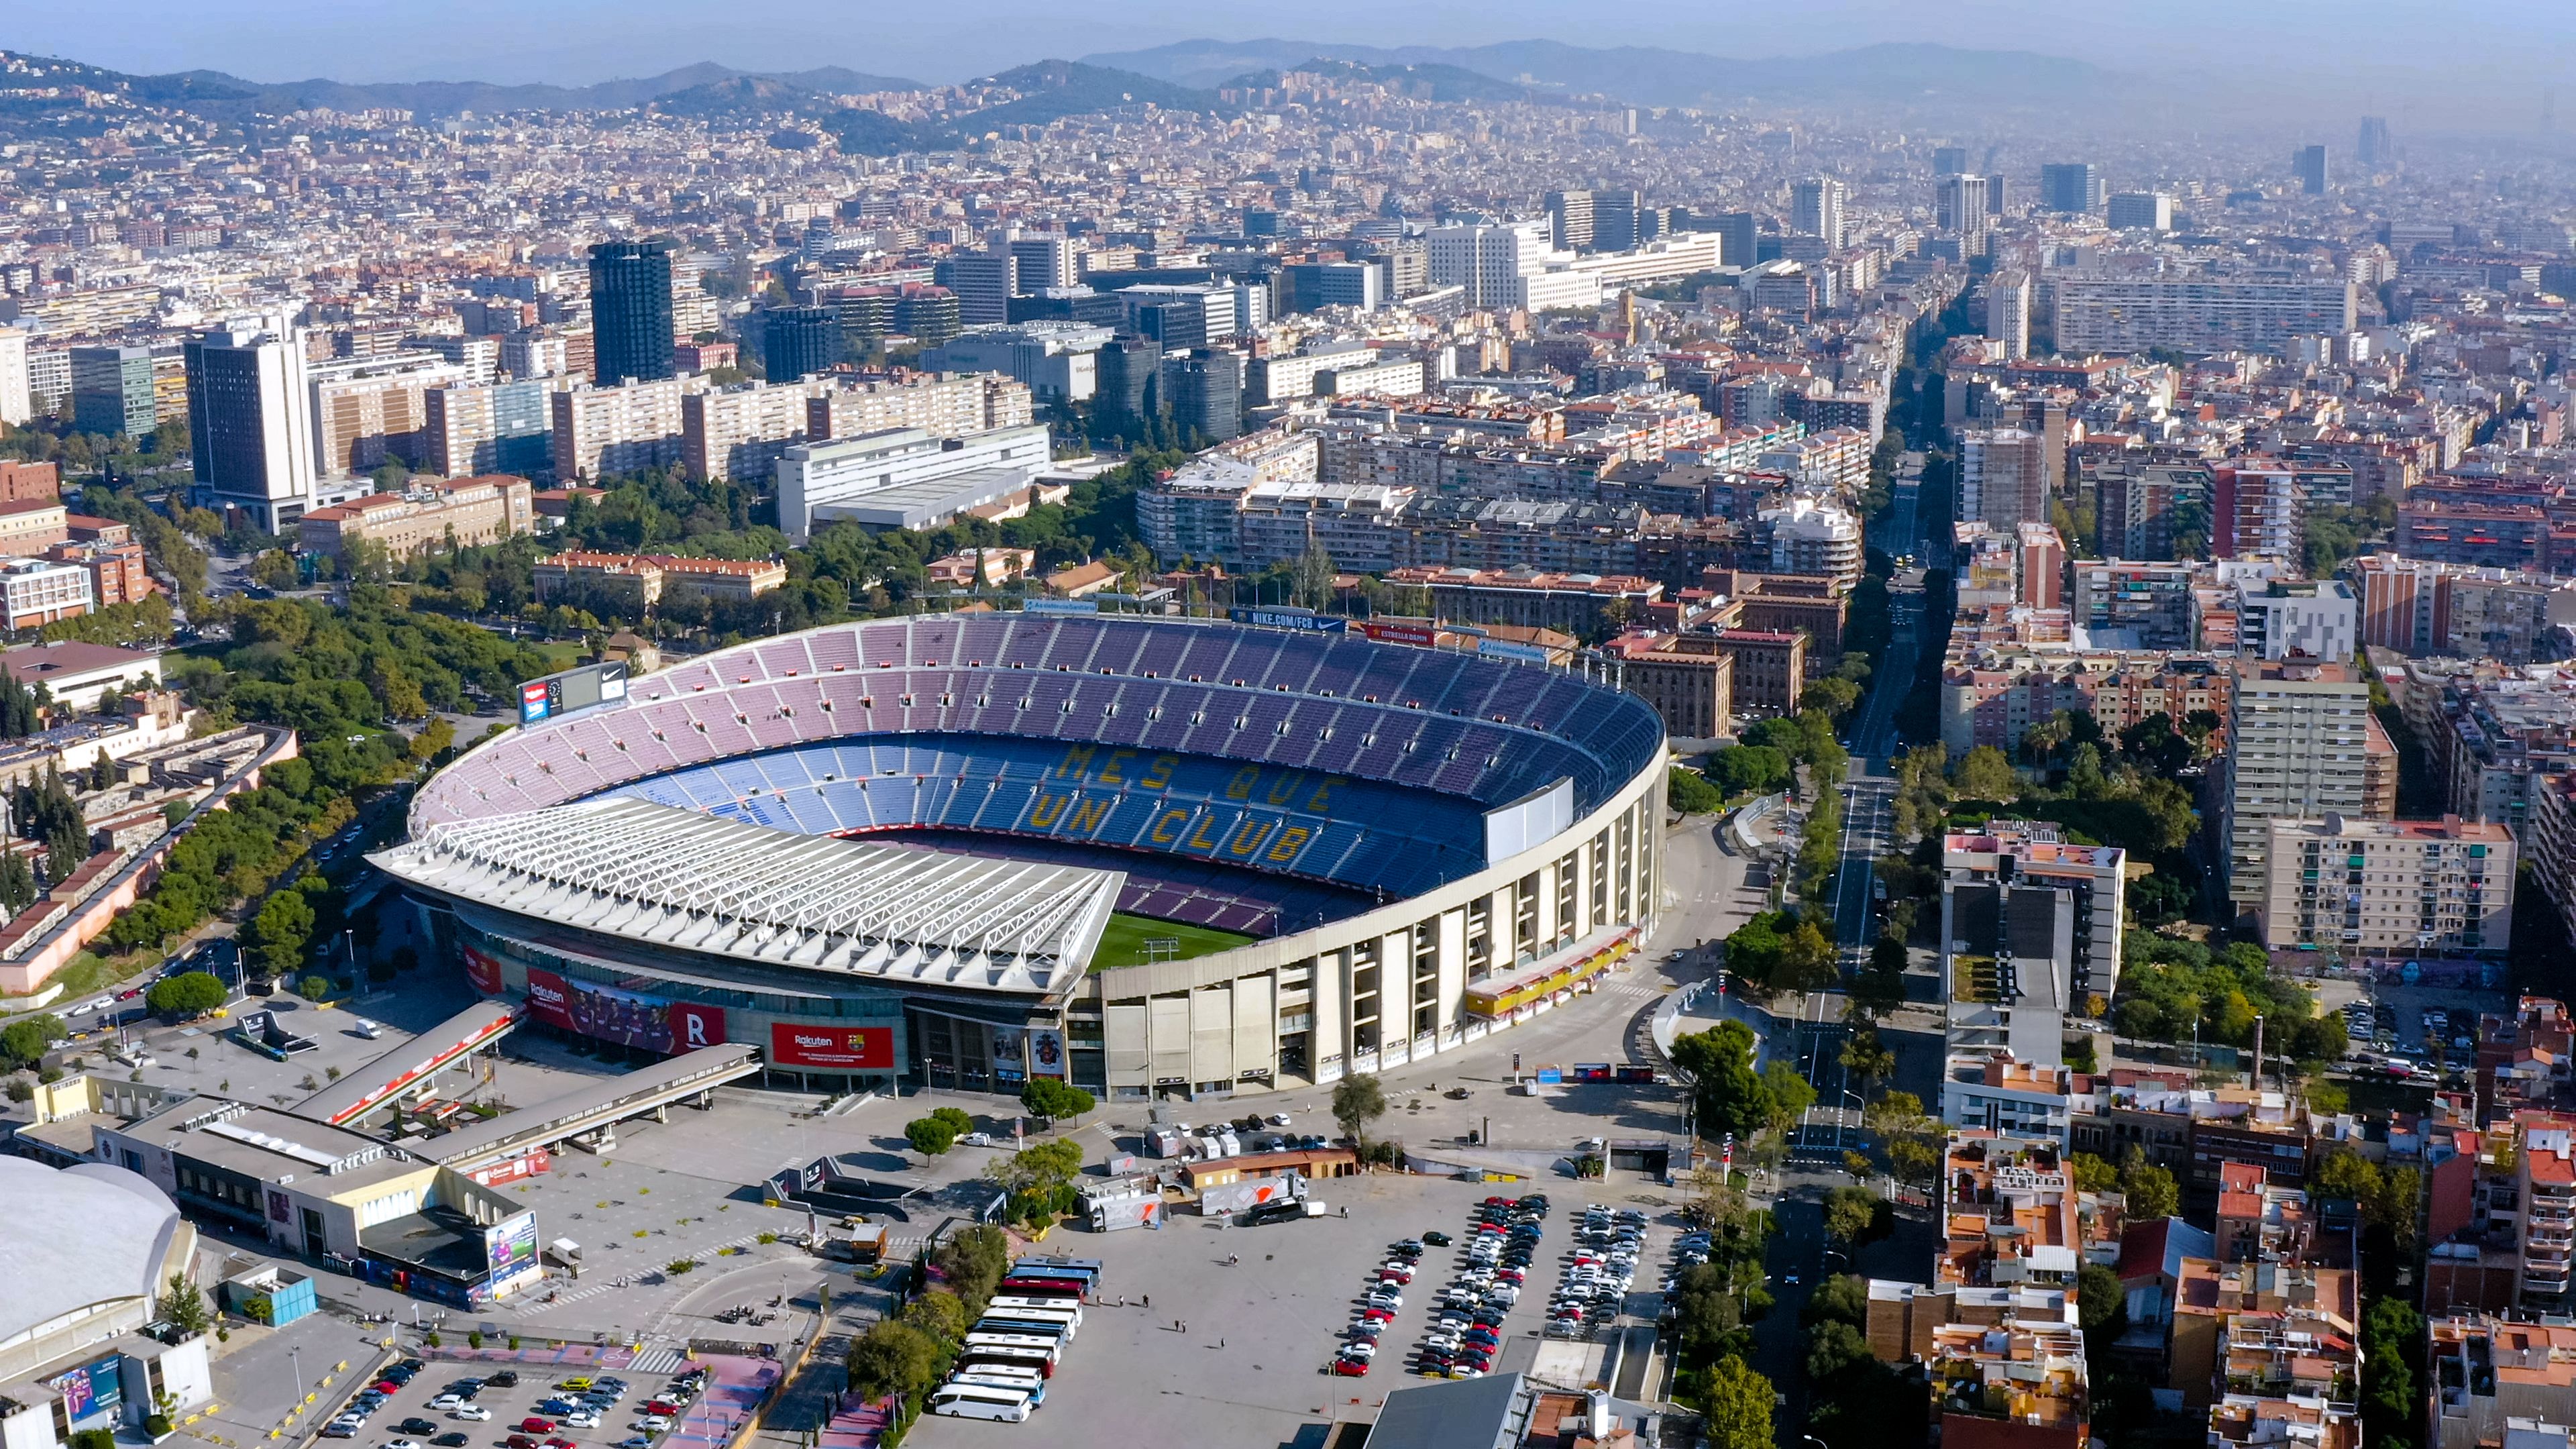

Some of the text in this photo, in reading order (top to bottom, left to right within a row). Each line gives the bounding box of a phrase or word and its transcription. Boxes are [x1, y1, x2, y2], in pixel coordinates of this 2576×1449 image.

[1252, 612, 1313, 629] NIKE.COM/FCB
[1381, 631, 1428, 642] ESTRELLA DAMM
[1226, 765, 1349, 811] QUE
[1031, 794, 1309, 861] UN CLUB
[531, 982, 564, 1004] Rakuten
[686, 1013, 708, 1044] R
[795, 1035, 833, 1046] Rakuten
[672, 1079, 678, 1087] LA
